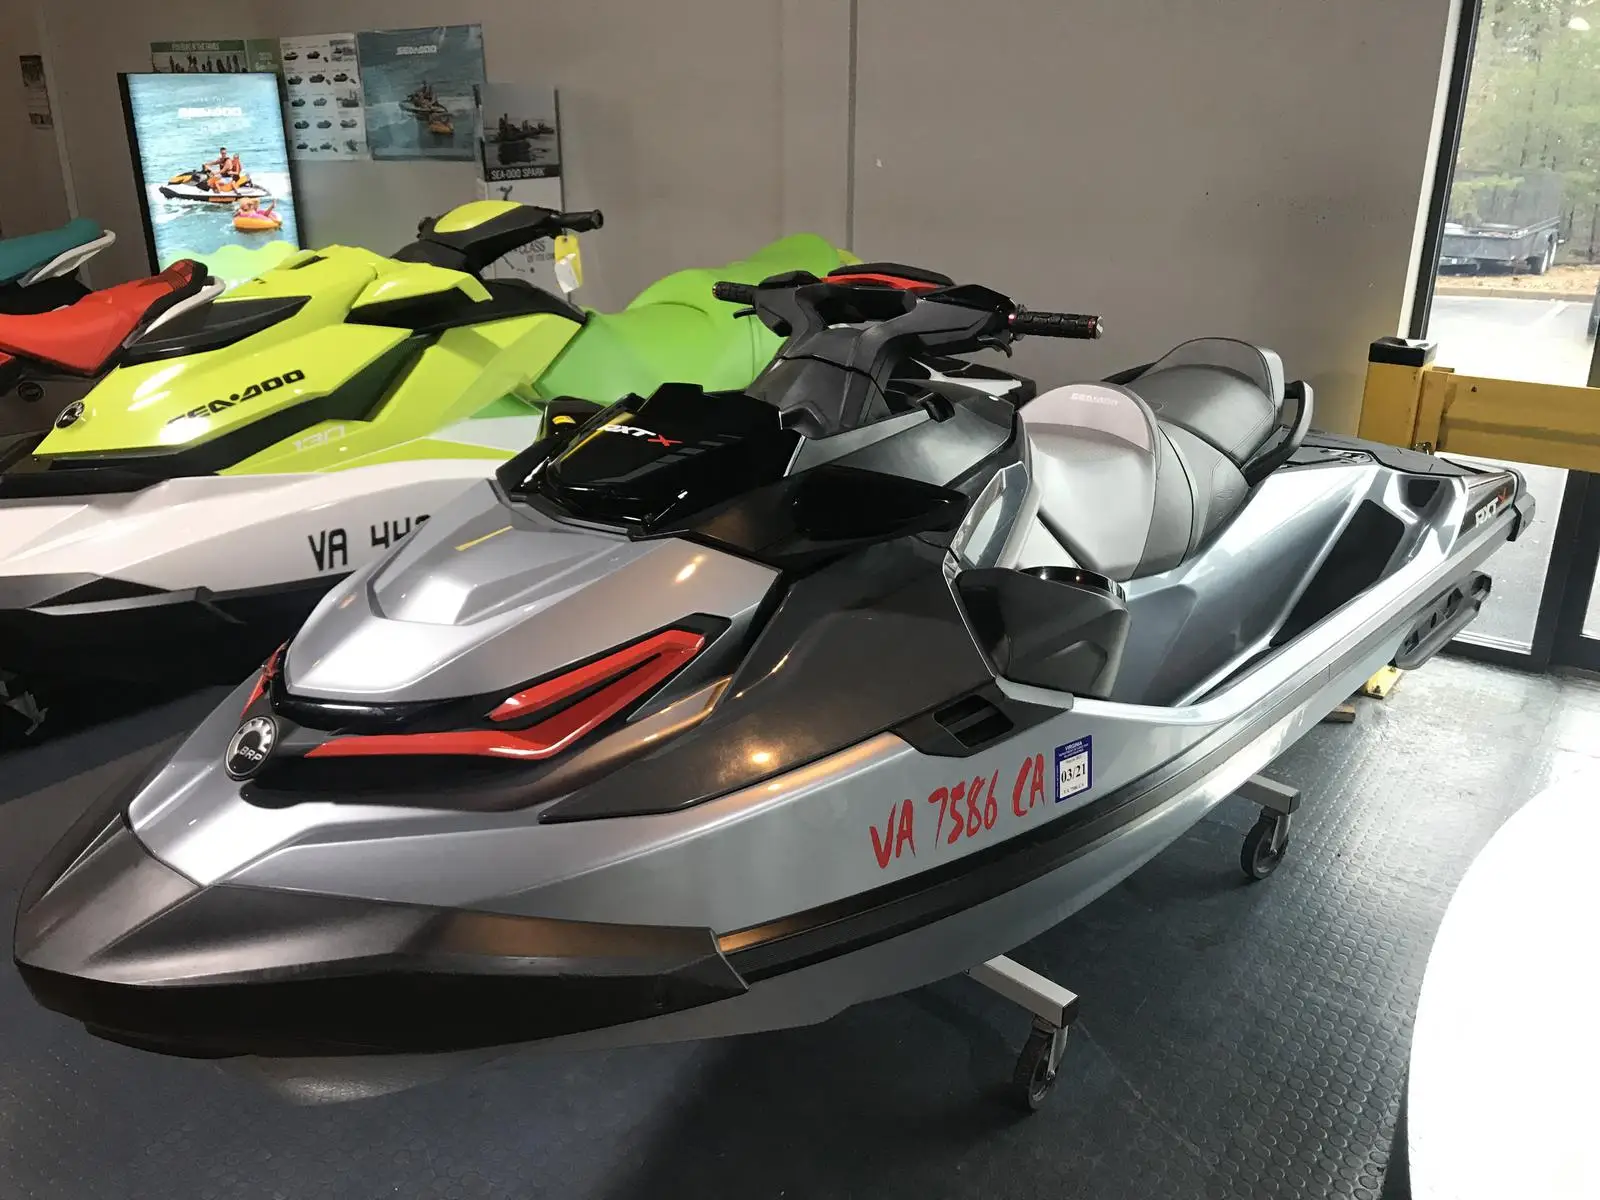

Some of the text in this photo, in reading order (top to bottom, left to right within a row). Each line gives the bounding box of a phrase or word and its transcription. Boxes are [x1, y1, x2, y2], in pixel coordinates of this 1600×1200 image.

[523, 168, 545, 177] SPARK
[308, 514, 431, 572] VA 44
[239, 746, 263, 762] BRP
[1061, 763, 1086, 783] 03/21
[869, 799, 917, 869] VA
[928, 769, 999, 849] 7586
[1012, 753, 1046, 818] CA
